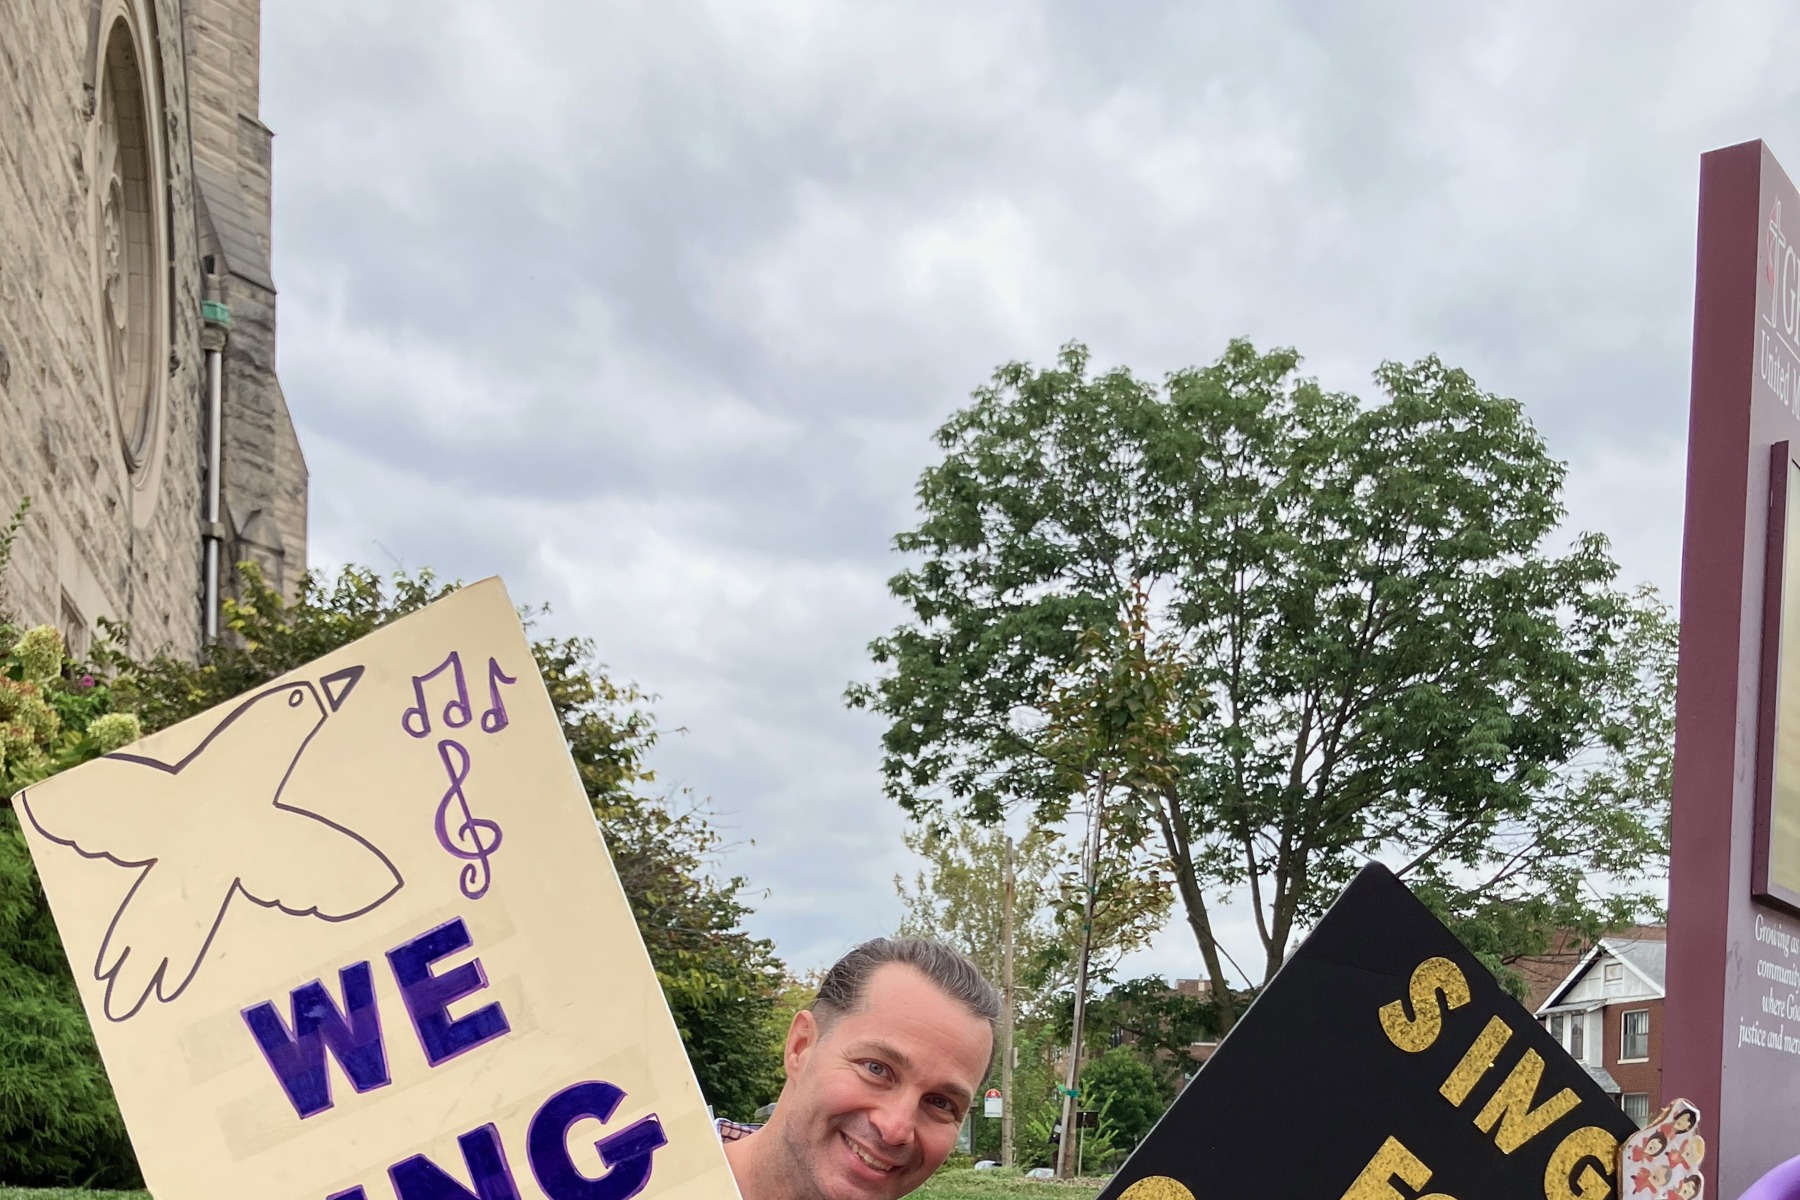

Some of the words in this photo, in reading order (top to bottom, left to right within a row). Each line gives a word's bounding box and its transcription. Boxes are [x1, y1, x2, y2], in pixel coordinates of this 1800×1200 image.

[1761, 329, 1790, 406] United
[1755, 914, 1790, 957] Growing
[1791, 936, 1800, 955] as
[240, 916, 511, 1119] WE
[1762, 987, 1785, 1018] where
[1738, 1016, 1766, 1048] justice
[1767, 1024, 1783, 1051] and
